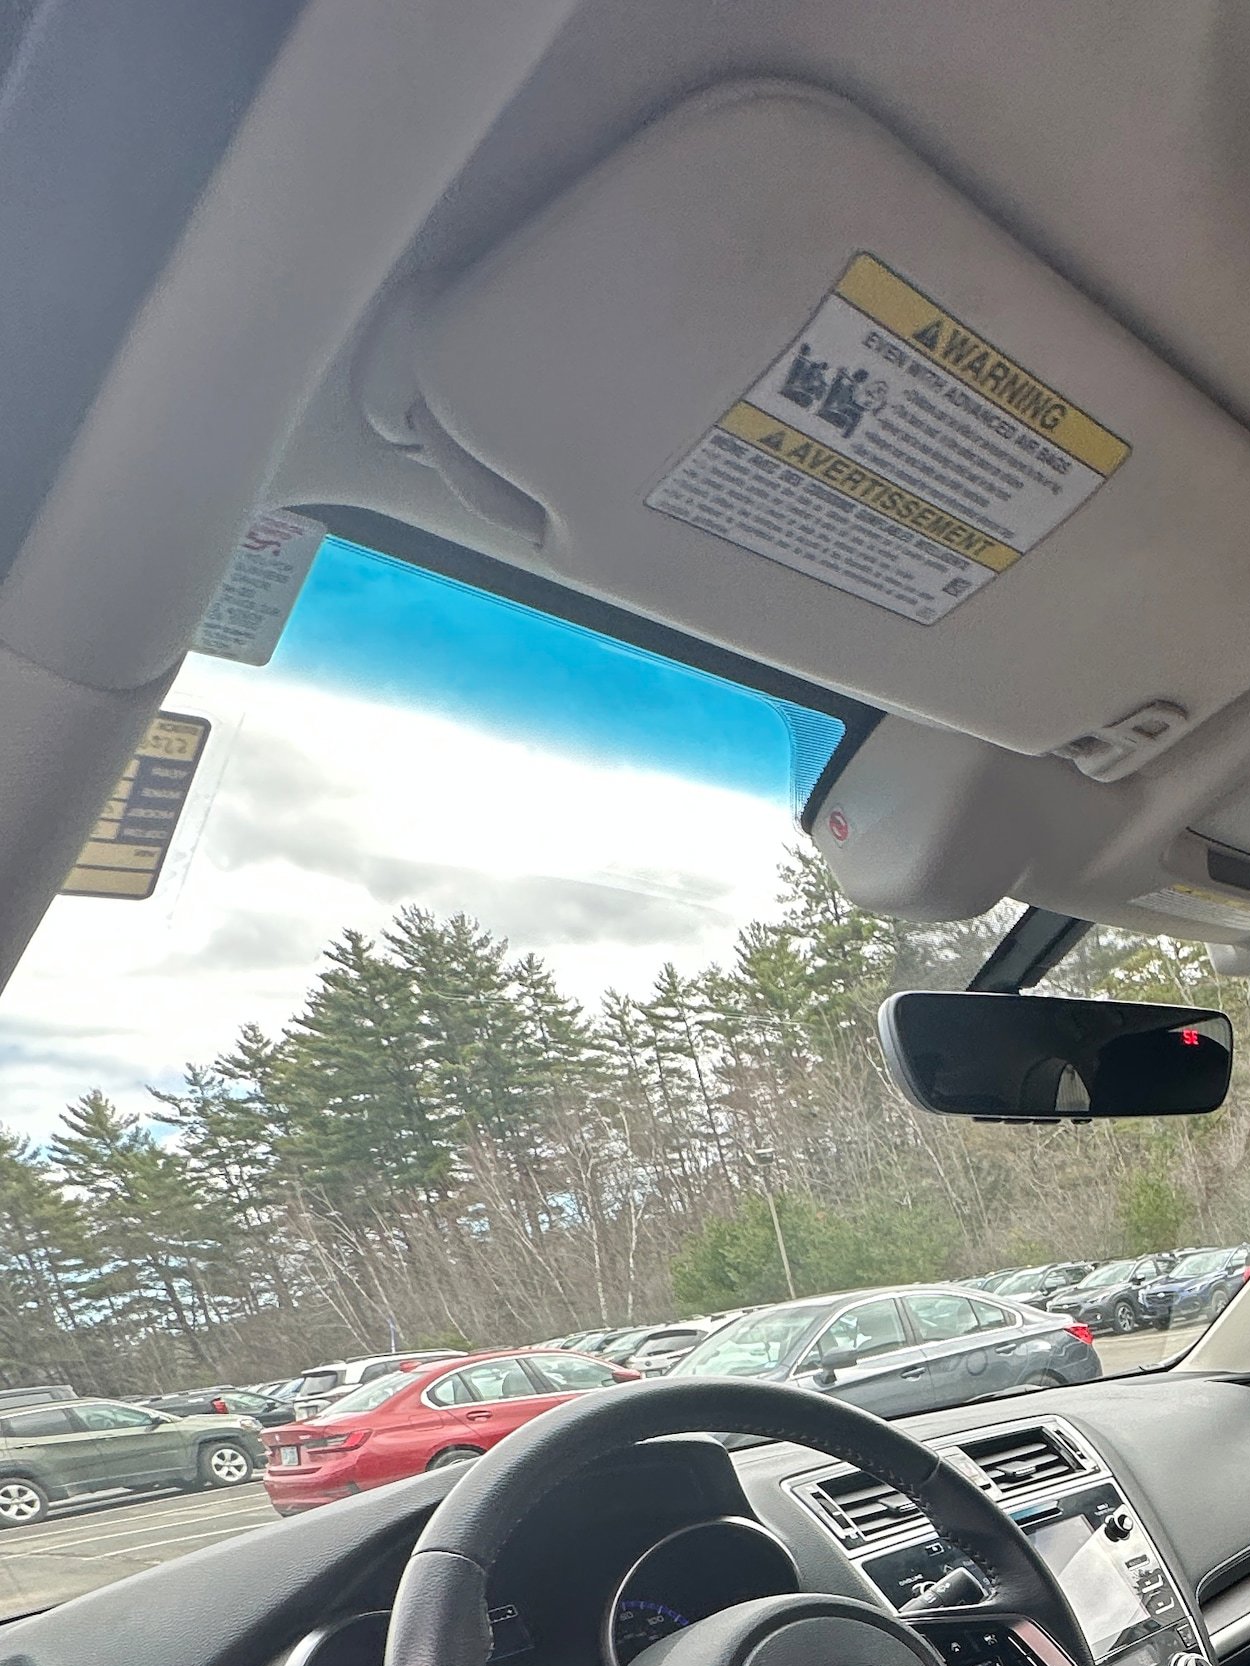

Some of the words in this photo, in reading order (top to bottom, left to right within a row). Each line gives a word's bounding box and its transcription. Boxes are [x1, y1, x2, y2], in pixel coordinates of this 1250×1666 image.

[862, 331, 908, 369] EVEN
[905, 359, 948, 393] WITH
[943, 385, 1017, 440] ADVANCED
[941, 328, 1068, 431] WARNING
[788, 441, 997, 558] AVERTISSEMENT
